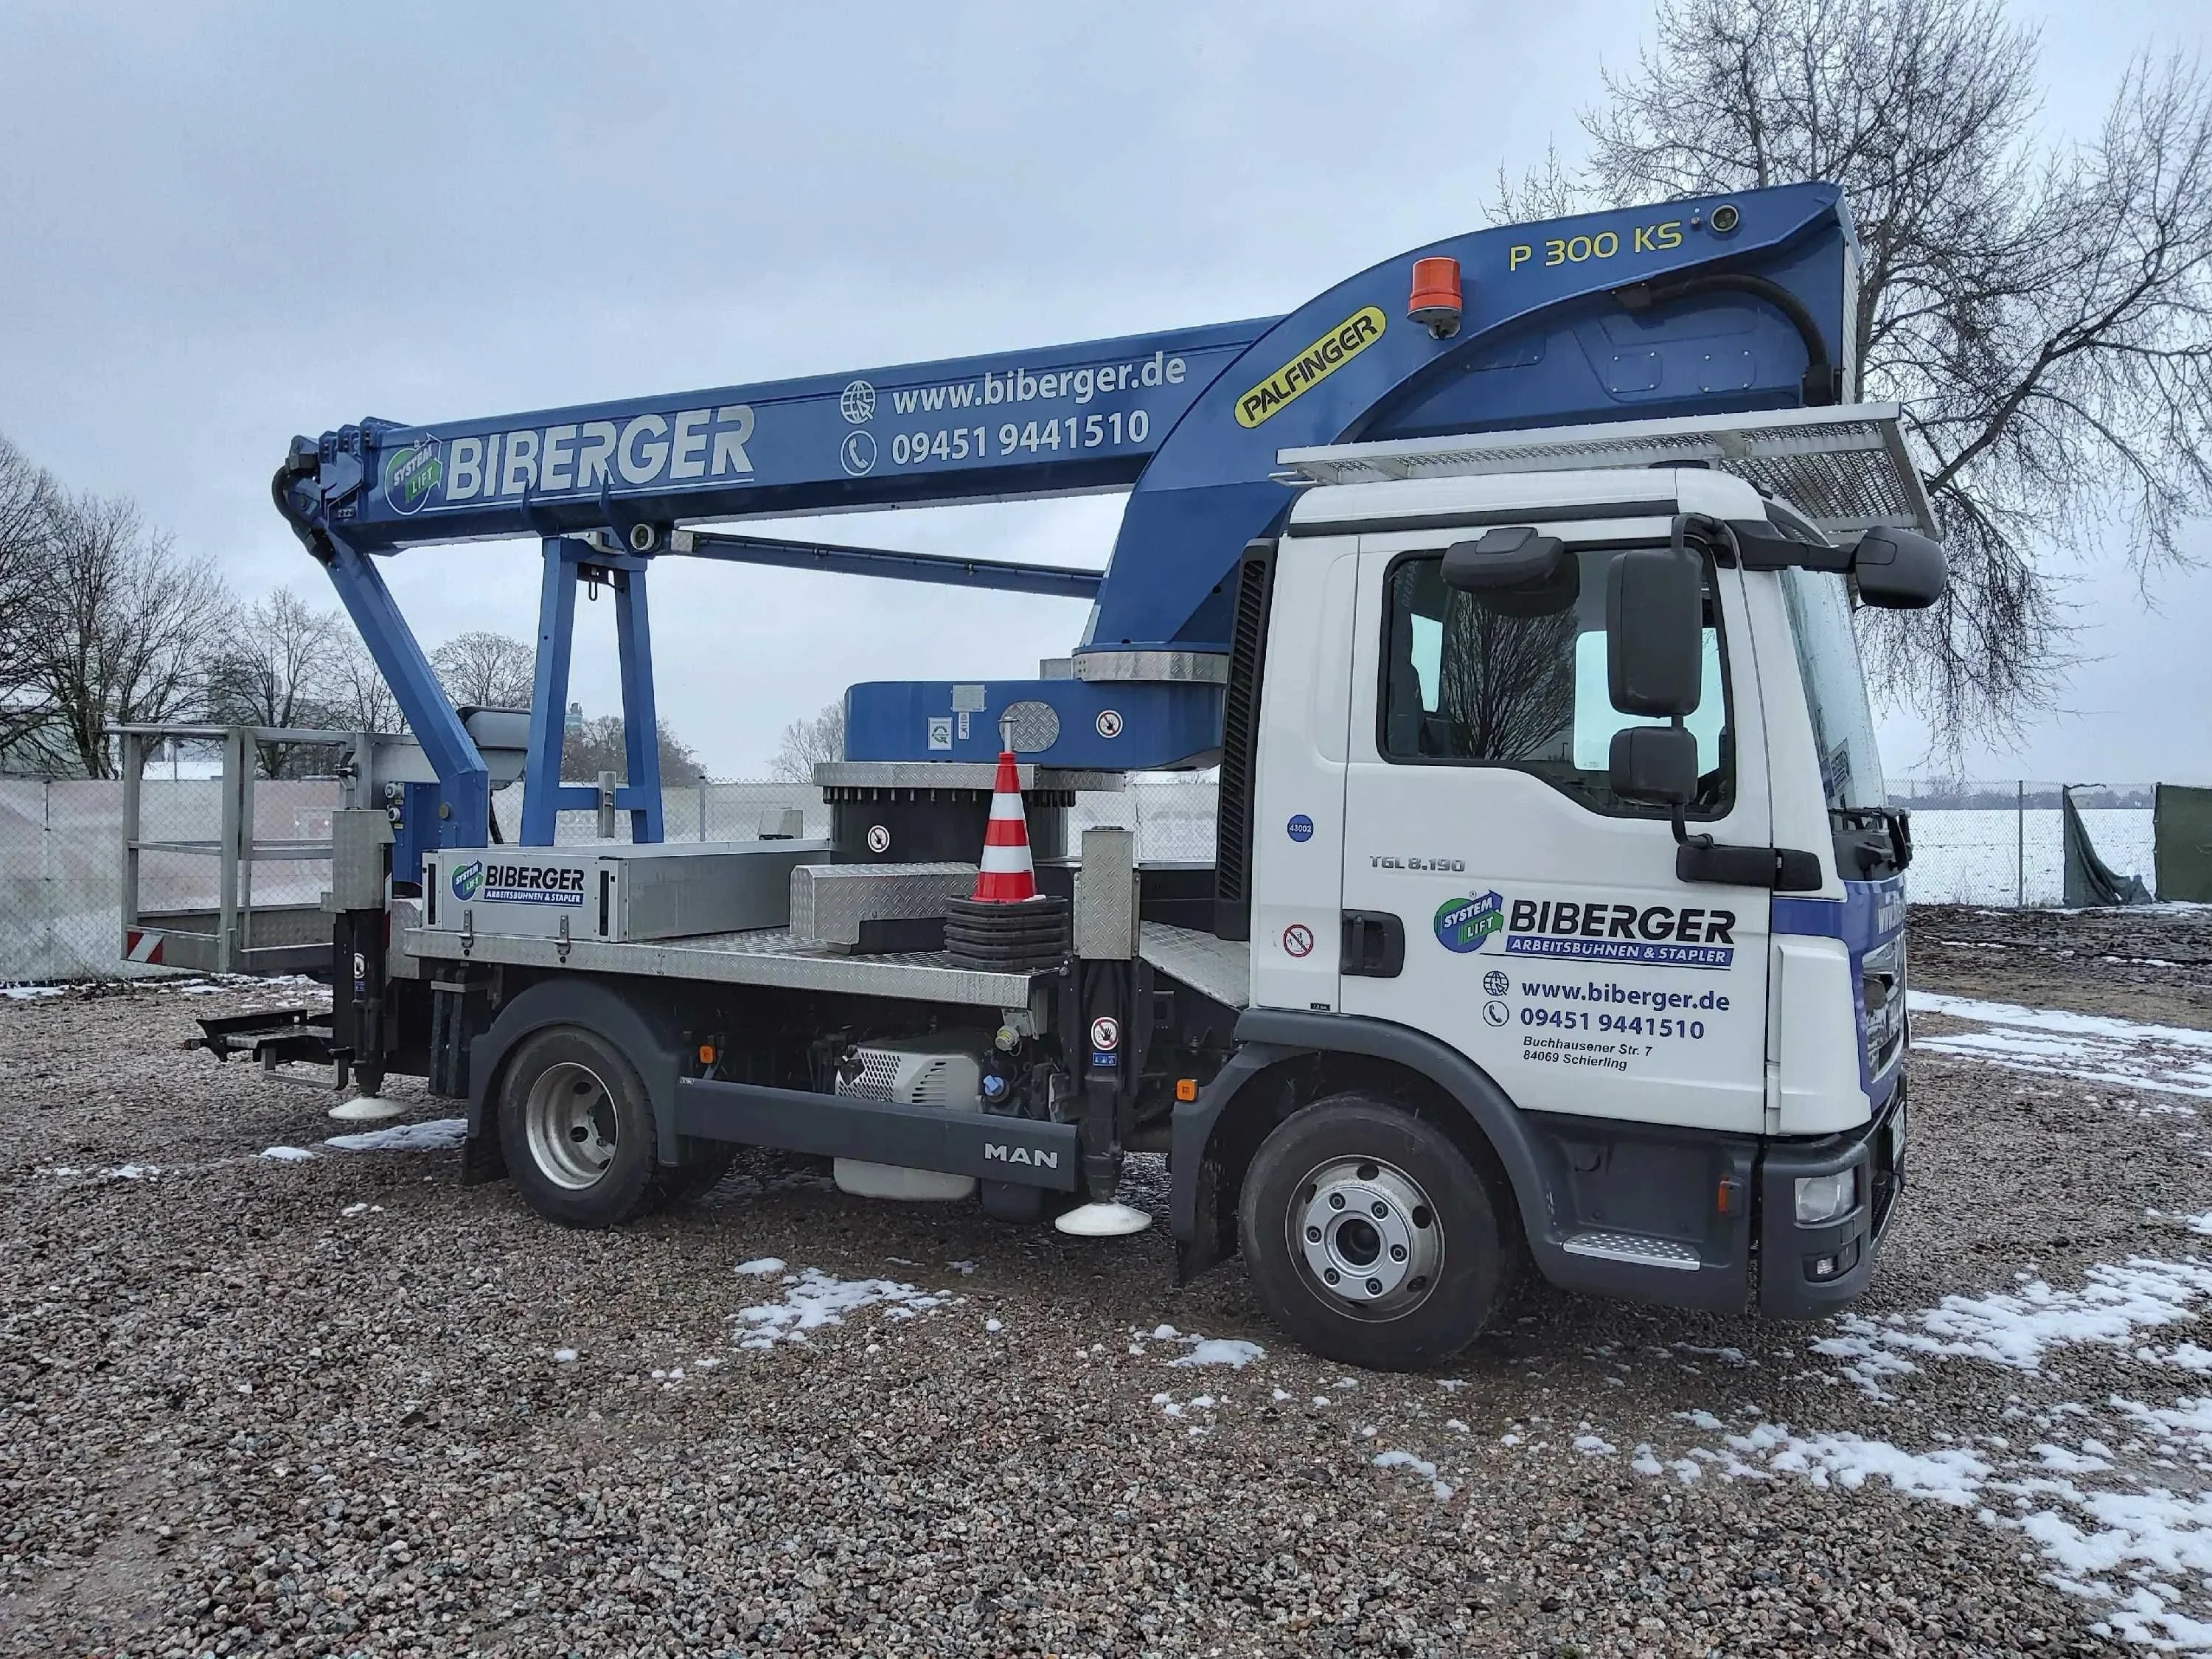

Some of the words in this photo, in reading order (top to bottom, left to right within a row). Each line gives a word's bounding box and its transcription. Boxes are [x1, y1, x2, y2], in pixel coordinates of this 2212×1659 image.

[1509, 245, 1532, 272] P
[1545, 231, 1619, 266] 300
[1634, 220, 1683, 254] KS
[1242, 315, 1379, 422] PALFINGER
[892, 350, 1187, 415] www.biberger.de
[891, 425, 987, 465] 09451
[998, 409, 1150, 456] 9441510
[393, 444, 433, 487] SYSTEM
[445, 404, 756, 501] BIBERGER
[411, 466, 434, 495] LIFT
[1289, 824, 1312, 832] 43002
[455, 863, 479, 886] SYSTEM
[1369, 856, 1405, 869] TGL
[1407, 858, 1465, 872] 8.190
[466, 877, 479, 891] LIFT
[484, 865, 585, 891] BIBERGER
[544, 893, 551, 901] &
[551, 893, 581, 903] STAPLER
[1444, 896, 1494, 928] SYSTEM
[1509, 899, 1736, 945] BIBERGER
[1467, 916, 1494, 939] LIFT
[1511, 939, 1641, 958] ARBEITSBÜHNEN
[1642, 946, 1655, 959] &
[1658, 947, 1727, 963] STAPLER
[1521, 982, 1730, 1011] www.biberger.de
[1520, 1007, 1590, 1031] 09451
[1598, 1013, 1705, 1040] 9441510
[1523, 1035, 1615, 1054] Buchhausener
[1618, 1043, 1640, 1056] Str.
[1644, 1046, 1653, 1056] 7
[1523, 1049, 1559, 1062] 84069
[1562, 1054, 1627, 1071] Schierling
[984, 1143, 1057, 1169] MAN
